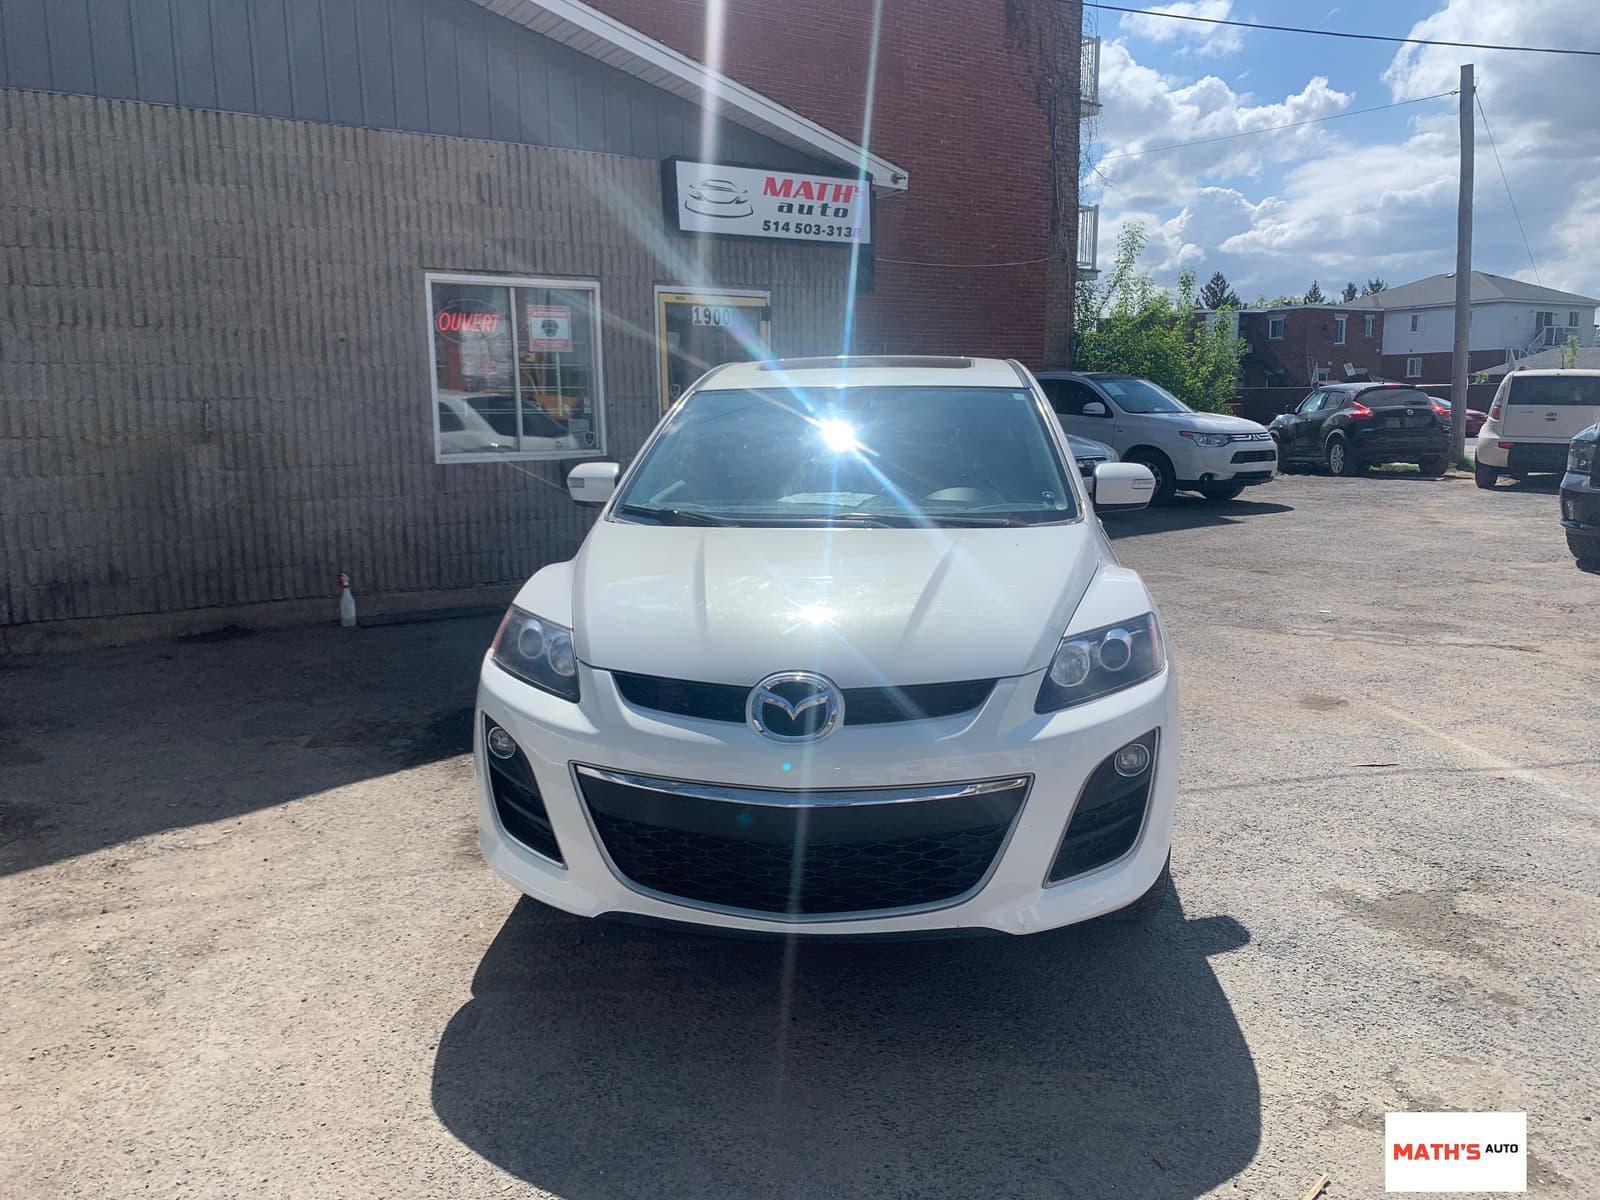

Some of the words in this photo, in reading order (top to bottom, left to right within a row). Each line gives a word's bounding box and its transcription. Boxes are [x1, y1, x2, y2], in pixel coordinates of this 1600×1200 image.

[778, 202, 848, 218] auto
[762, 220, 790, 233] 514
[438, 311, 499, 333] OUVERT
[693, 307, 730, 325] 1900
